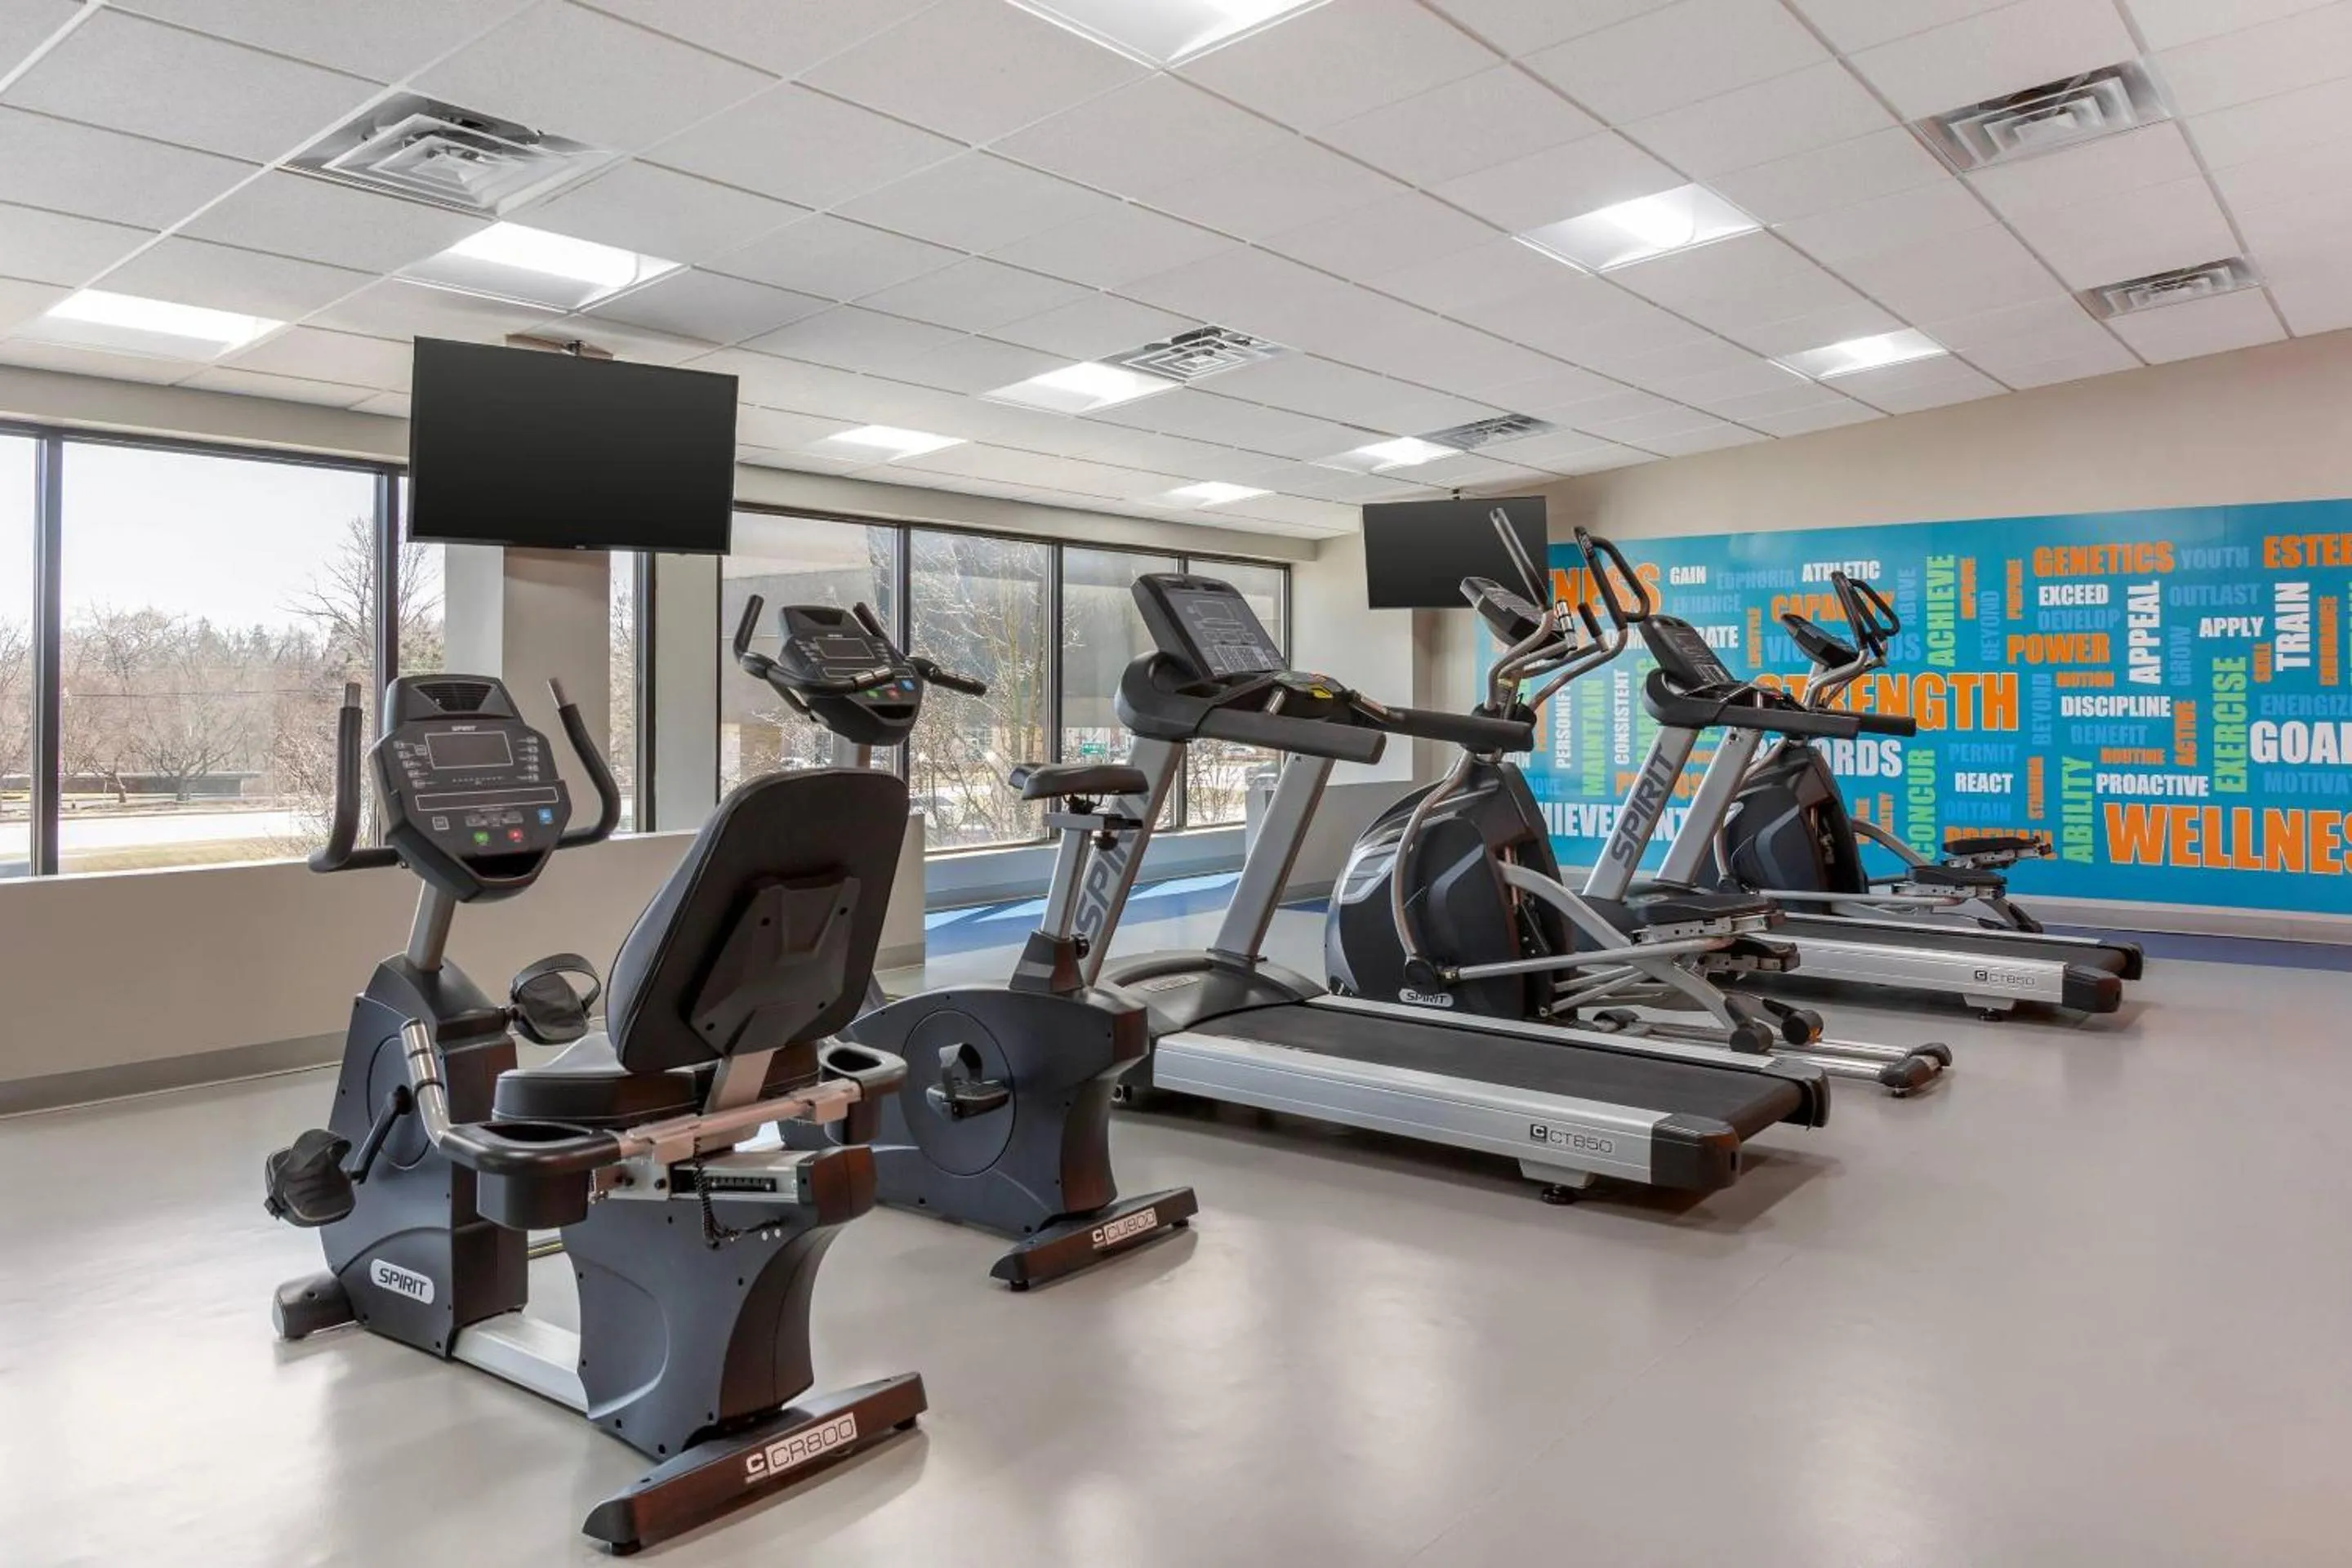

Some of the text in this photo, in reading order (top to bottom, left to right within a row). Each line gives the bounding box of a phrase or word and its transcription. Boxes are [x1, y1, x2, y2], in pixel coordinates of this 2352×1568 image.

[2033, 541, 2175, 577] GENETICS
[2180, 546, 2250, 570] YOUTH
[1669, 565, 1707, 585] GAIN
[1716, 568, 1796, 590] EUPHORIA
[1673, 594, 1741, 614] ENHANCE
[1897, 568, 1917, 626] ABOVE
[2038, 584, 2109, 606] EXCEED
[2169, 583, 2261, 607] OUTLAST
[1927, 554, 1955, 667] ACHIEVE
[2038, 608, 2121, 630] DEVELOP
[1980, 590, 2000, 662] BEYOND
[2127, 581, 2161, 684] APPEAL
[2199, 616, 2265, 638] APPLY
[2274, 582, 2310, 671] TRAIN
[2007, 632, 2110, 665] POWER
[2169, 625, 2192, 686] GROW
[2056, 670, 2114, 688] MOTION
[1754, 671, 2019, 731] ENGTH
[2032, 673, 2052, 746] BEYOND
[2061, 695, 2172, 717] DISCIPLINE
[2261, 694, 2352, 716] ENERGIZ
[1555, 687, 1572, 769] PERSONIF
[1613, 668, 1630, 765] CONSISTENT
[2212, 656, 2247, 792] EXERCISE
[1581, 679, 1606, 795] MAINTAIN
[2070, 724, 2148, 746] BENEFIT
[2174, 699, 2197, 766] ACTIVE
[1949, 743, 2017, 764] PERMIT
[1954, 773, 2014, 794] REACT
[2096, 773, 2210, 797] PROACTIVE
[2263, 771, 2352, 796] MOTIVA
[1611, 742, 1674, 868] SPIRIT
[1907, 749, 1936, 861] CONCUR
[1944, 800, 2011, 822] OBTAIN
[2061, 755, 2094, 864] ABILITY
[1406, 992, 1448, 1004] SPIRIT
[1550, 1129, 1613, 1153] CT850
[378, 1267, 426, 1297] SPIRIT
[771, 1418, 854, 1468] CR800
